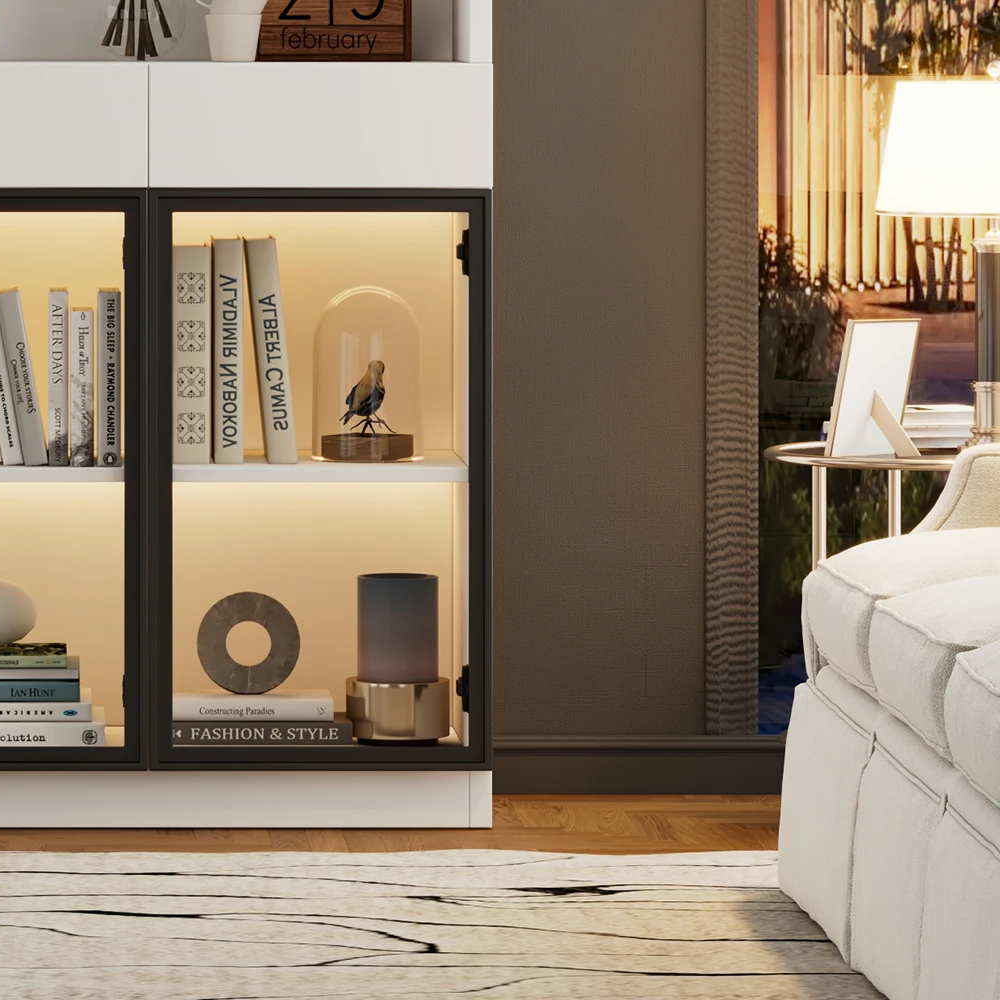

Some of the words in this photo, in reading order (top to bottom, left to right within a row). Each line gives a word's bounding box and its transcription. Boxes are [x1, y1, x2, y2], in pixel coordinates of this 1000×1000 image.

[280, 26, 378, 55] february
[106, 298, 115, 313] THE
[52, 303, 63, 347] AFTER
[106, 315, 115, 329] BIG
[106, 331, 115, 353] SLEEP
[22, 365, 30, 385] YOUR
[52, 351, 63, 385] DAYS
[106, 362, 115, 403] RAYMOND
[0, 393, 6, 401] TO
[24, 386, 36, 414] STORIES
[2, 402, 10, 424] CHORD
[6, 425, 14, 448] SCALES
[106, 405, 115, 446] CHANDLER
[10, 688, 27, 698] IAN
[29, 688, 55, 698] HUNT
[199, 707, 244, 717] Constructing
[245, 707, 275, 716] Paradies
[190, 728, 265, 740] FASHION
[269, 728, 283, 740] &
[287, 728, 339, 740] STYLE
